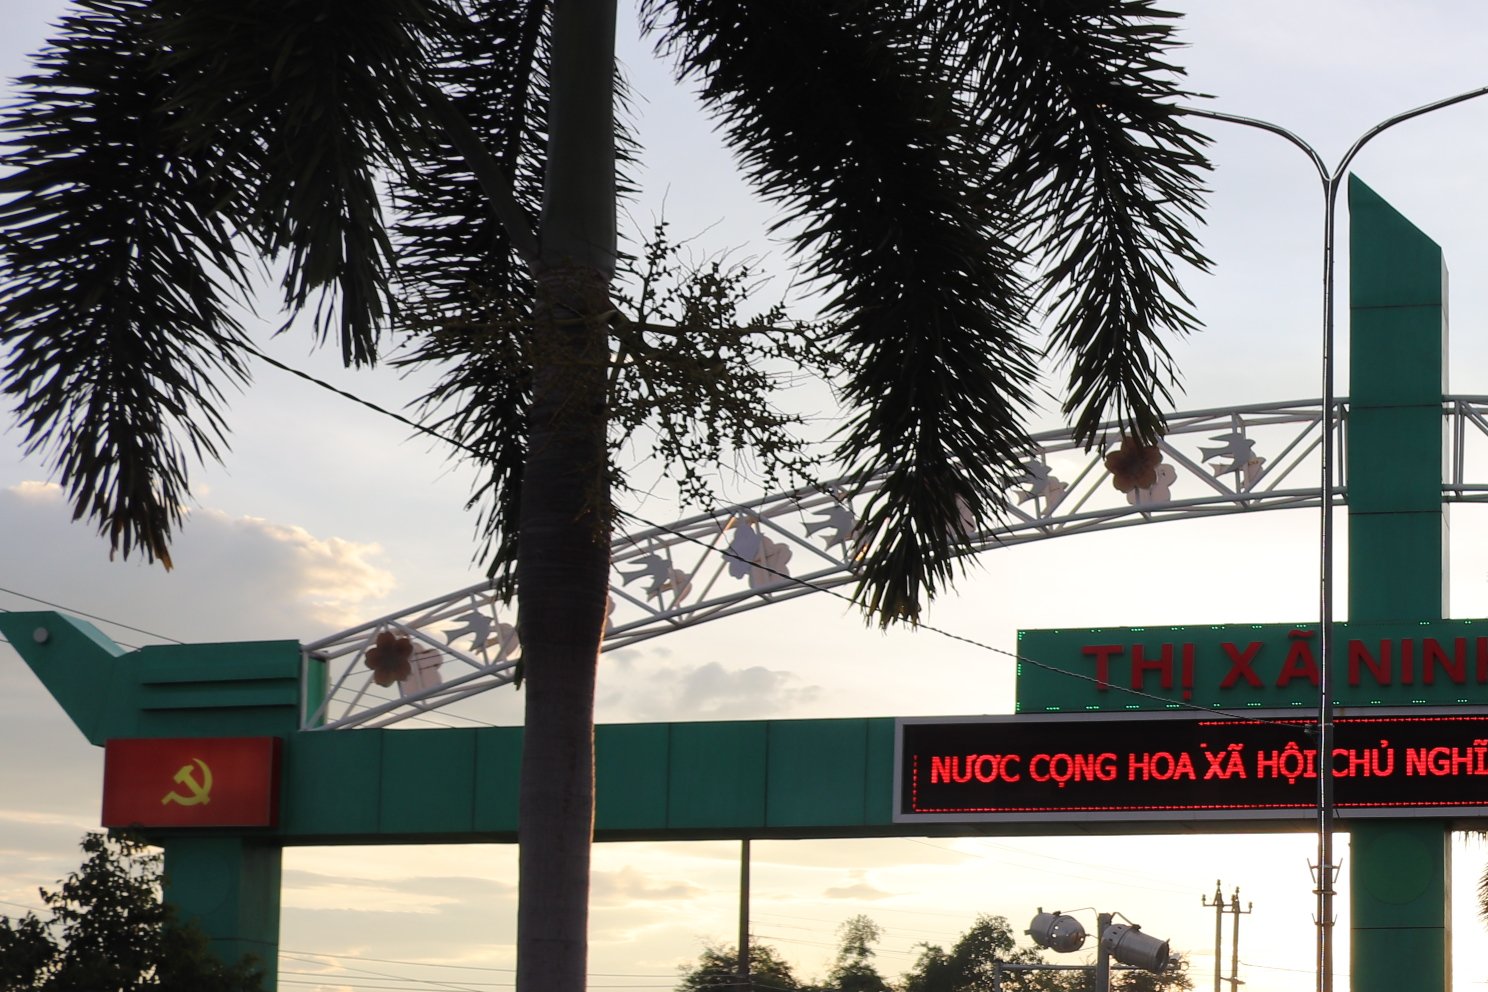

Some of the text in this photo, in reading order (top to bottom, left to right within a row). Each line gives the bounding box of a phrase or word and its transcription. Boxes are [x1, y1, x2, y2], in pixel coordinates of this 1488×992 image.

[1082, 644, 1194, 699] THỊ
[1221, 630, 1320, 688] XÃ
[1202, 743, 1247, 780] XÃ
[1257, 742, 1317, 784] HỘI
[1332, 740, 1394, 778] CHỦ
